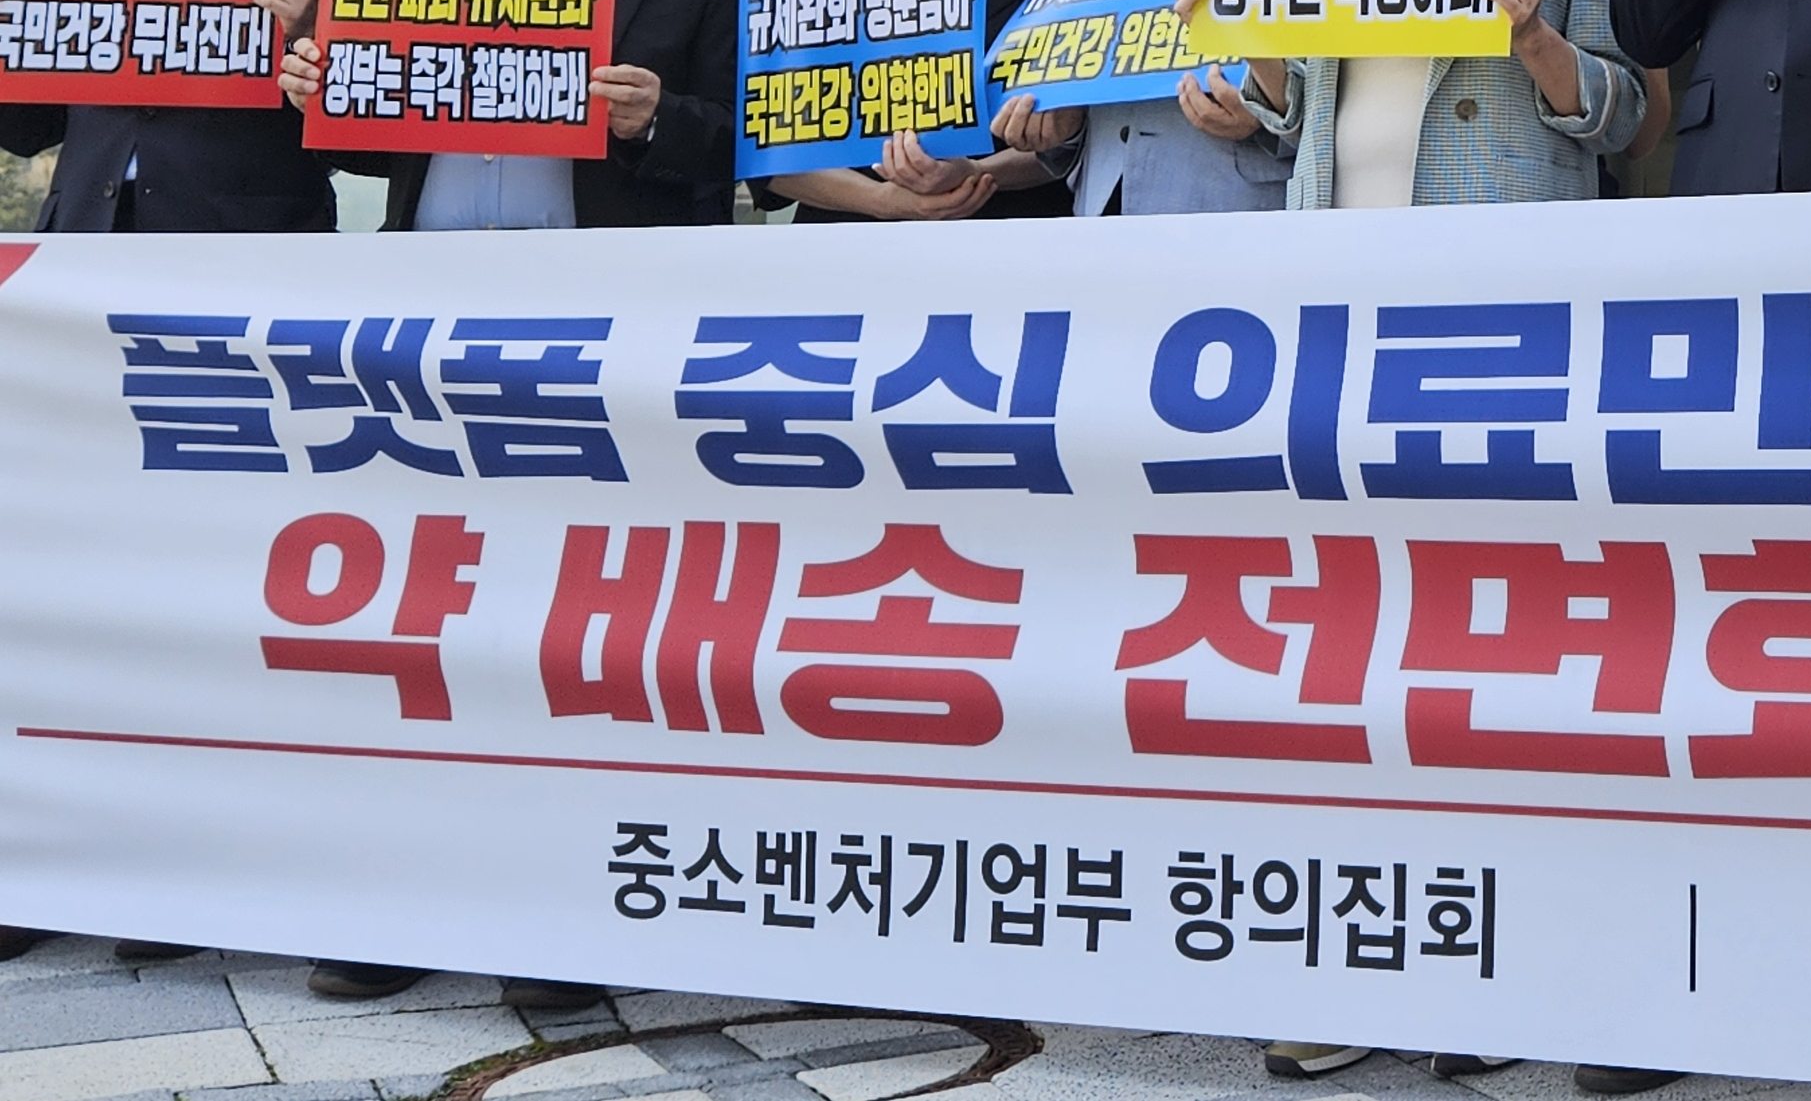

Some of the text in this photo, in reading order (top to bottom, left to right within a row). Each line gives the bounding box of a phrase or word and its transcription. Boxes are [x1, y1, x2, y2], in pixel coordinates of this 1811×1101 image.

[0, 0, 271, 75] 국민건강 무너진다!
[325, 42, 587, 122] 정부는 즉각 철회하라!
[992, 11, 1116, 90] 국민건강
[745, 52, 975, 146] 국민건강 위협한다!
[105, 312, 630, 483] 플랫폼
[674, 310, 1074, 495] 중심
[259, 511, 486, 721] 약
[539, 518, 1025, 747] 배송
[606, 818, 1498, 980] 중소벤처기업부 항의집회
